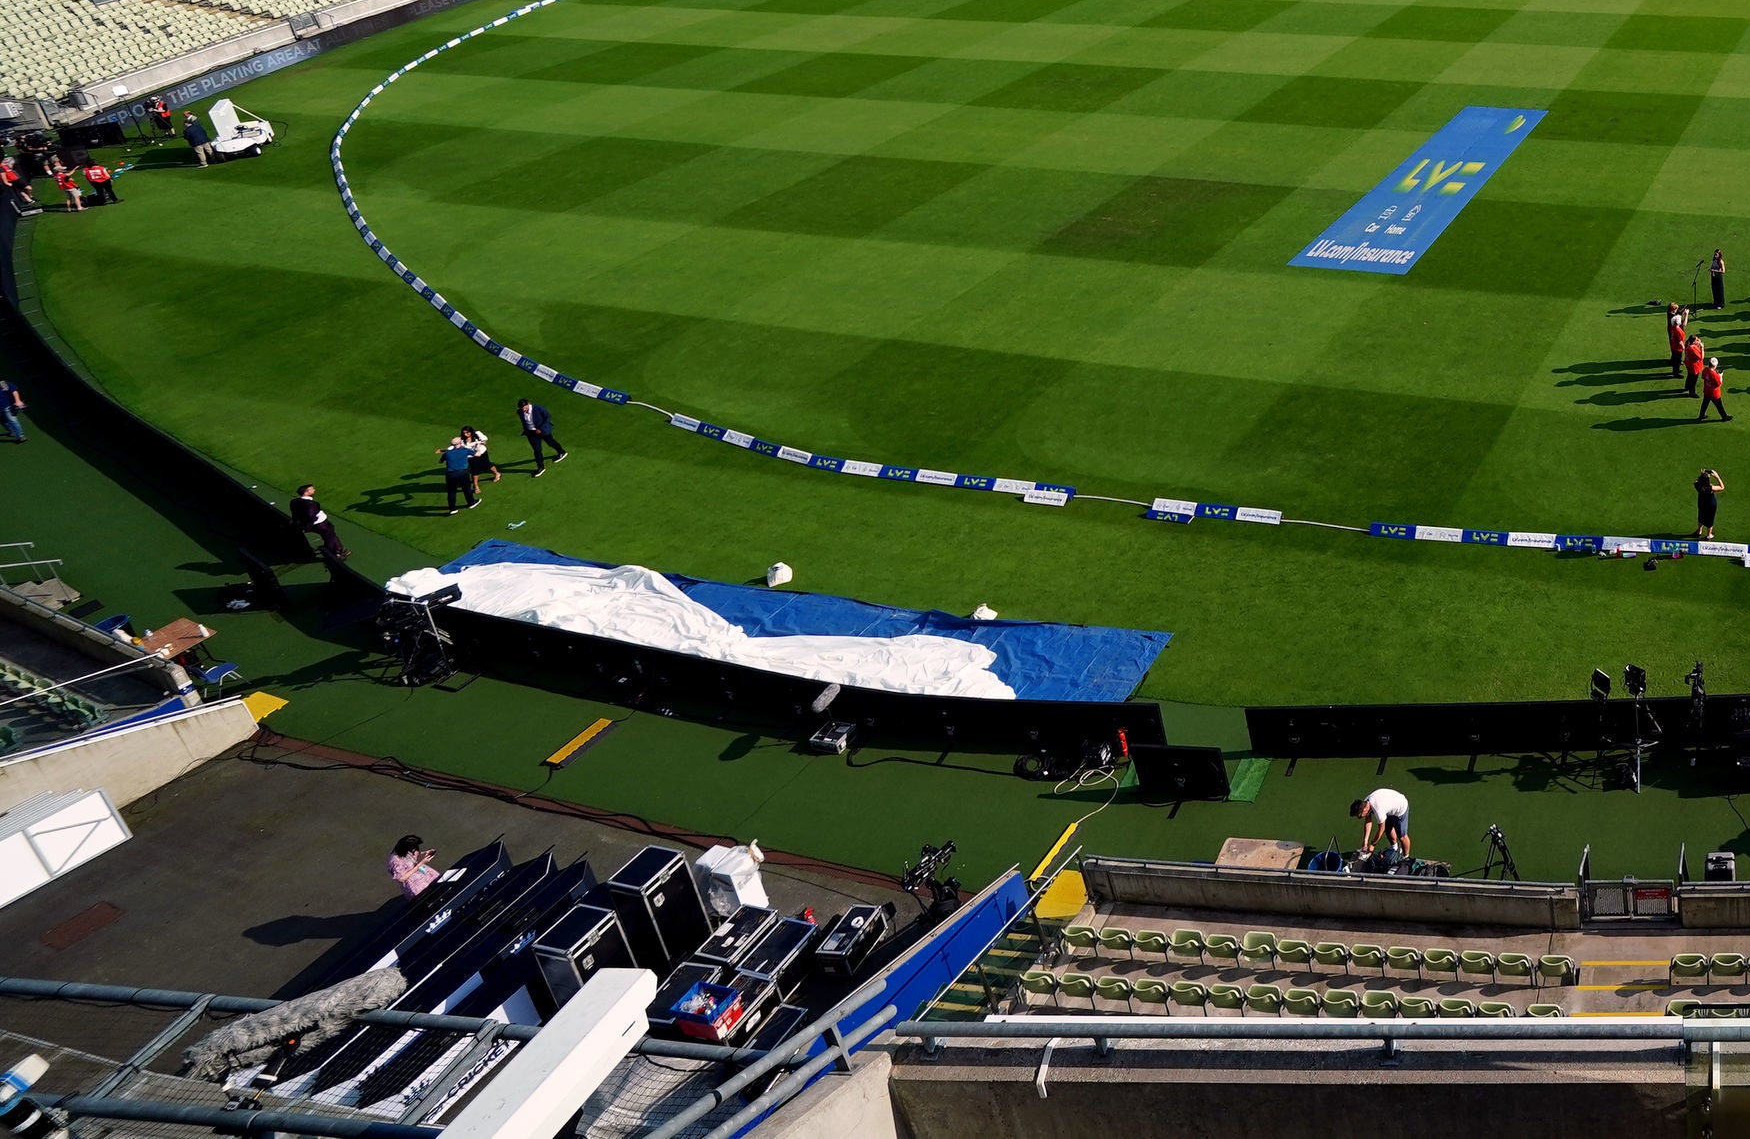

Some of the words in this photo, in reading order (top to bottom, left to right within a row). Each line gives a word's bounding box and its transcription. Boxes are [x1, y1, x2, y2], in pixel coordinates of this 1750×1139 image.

[168, 82, 199, 106] THE
[200, 59, 264, 96] PLAYING
[267, 46, 304, 69] AREA
[304, 37, 322, 53] AT
[1364, 222, 1380, 234] Car
[1384, 223, 1406, 235] Home
[1306, 239, 1416, 265] LV.com/insurance
[447, 1040, 516, 1098] CRICKET
